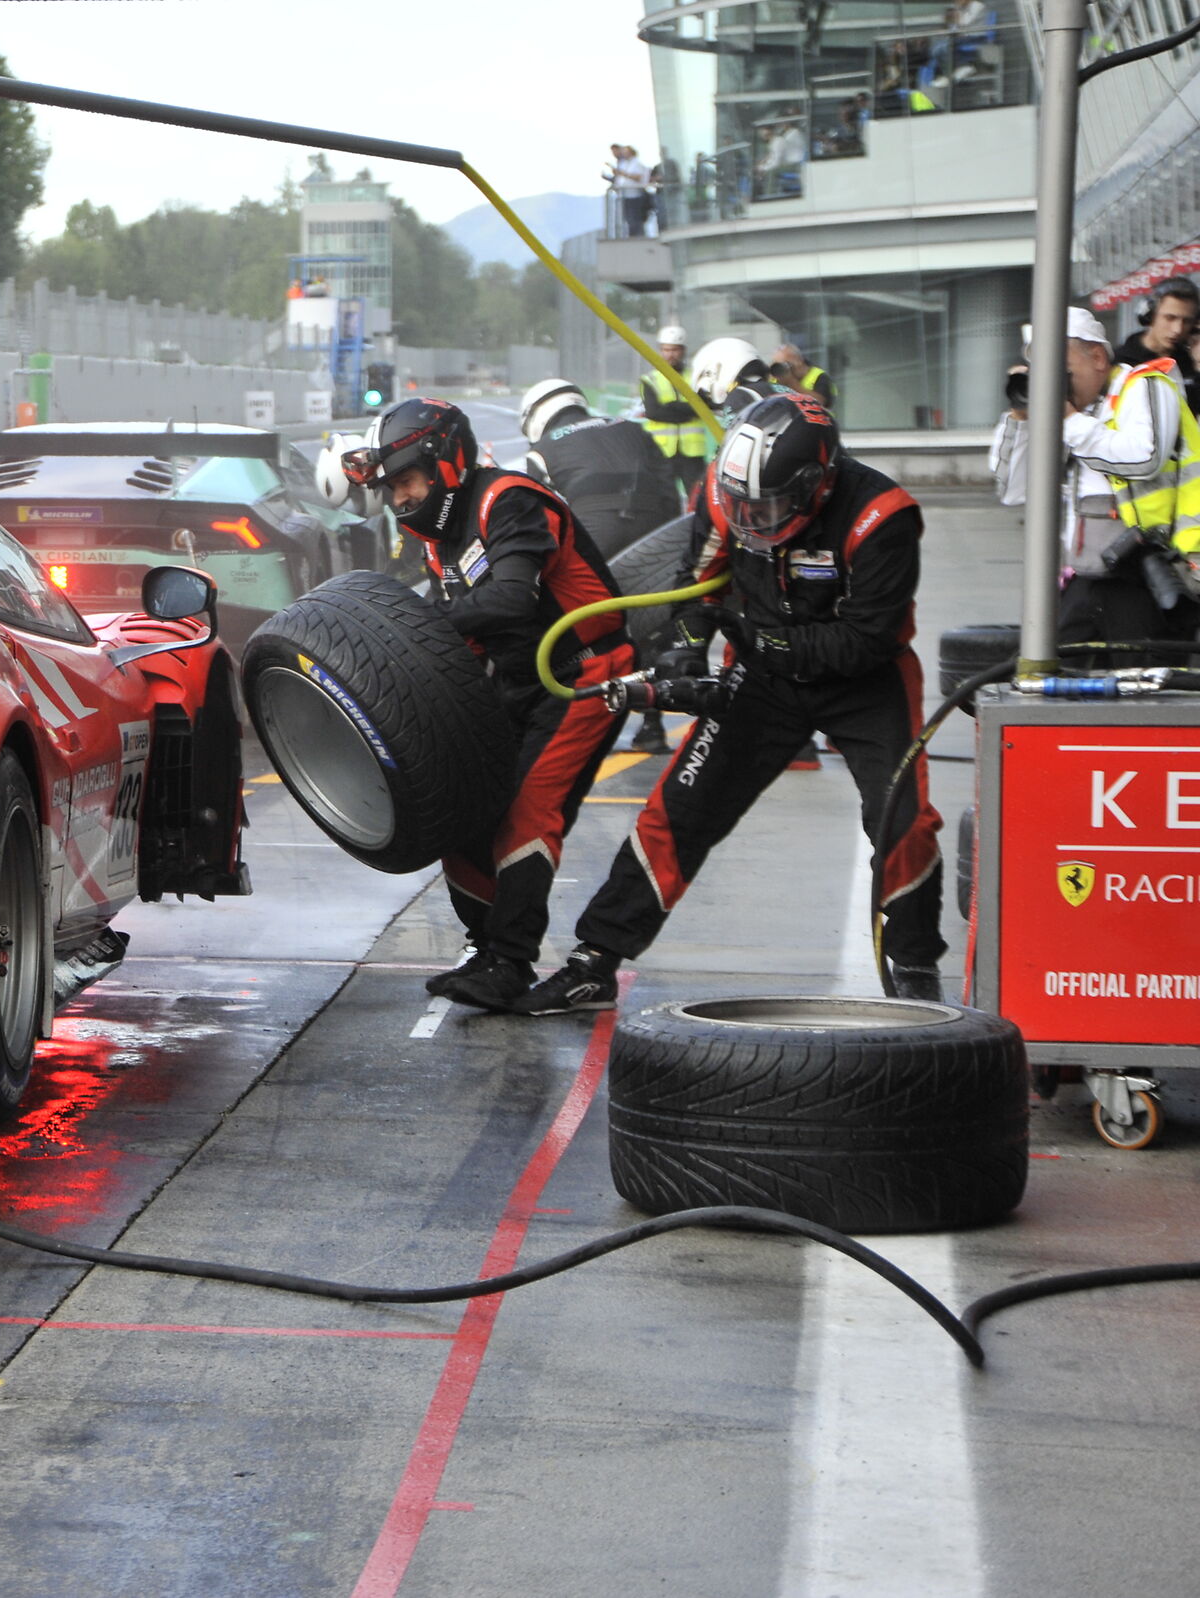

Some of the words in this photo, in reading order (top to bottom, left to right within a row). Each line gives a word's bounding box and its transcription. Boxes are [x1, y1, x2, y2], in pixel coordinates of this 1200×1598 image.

[435, 492, 455, 531] ANDREA
[47, 551, 113, 562] CIPRIANI
[323, 678, 391, 760] MICHELIN
[678, 717, 720, 787] RACING
[1105, 873, 1200, 903] RACI
[1045, 971, 1130, 998] OFFICIAL
[1136, 973, 1200, 1000] PARTN
